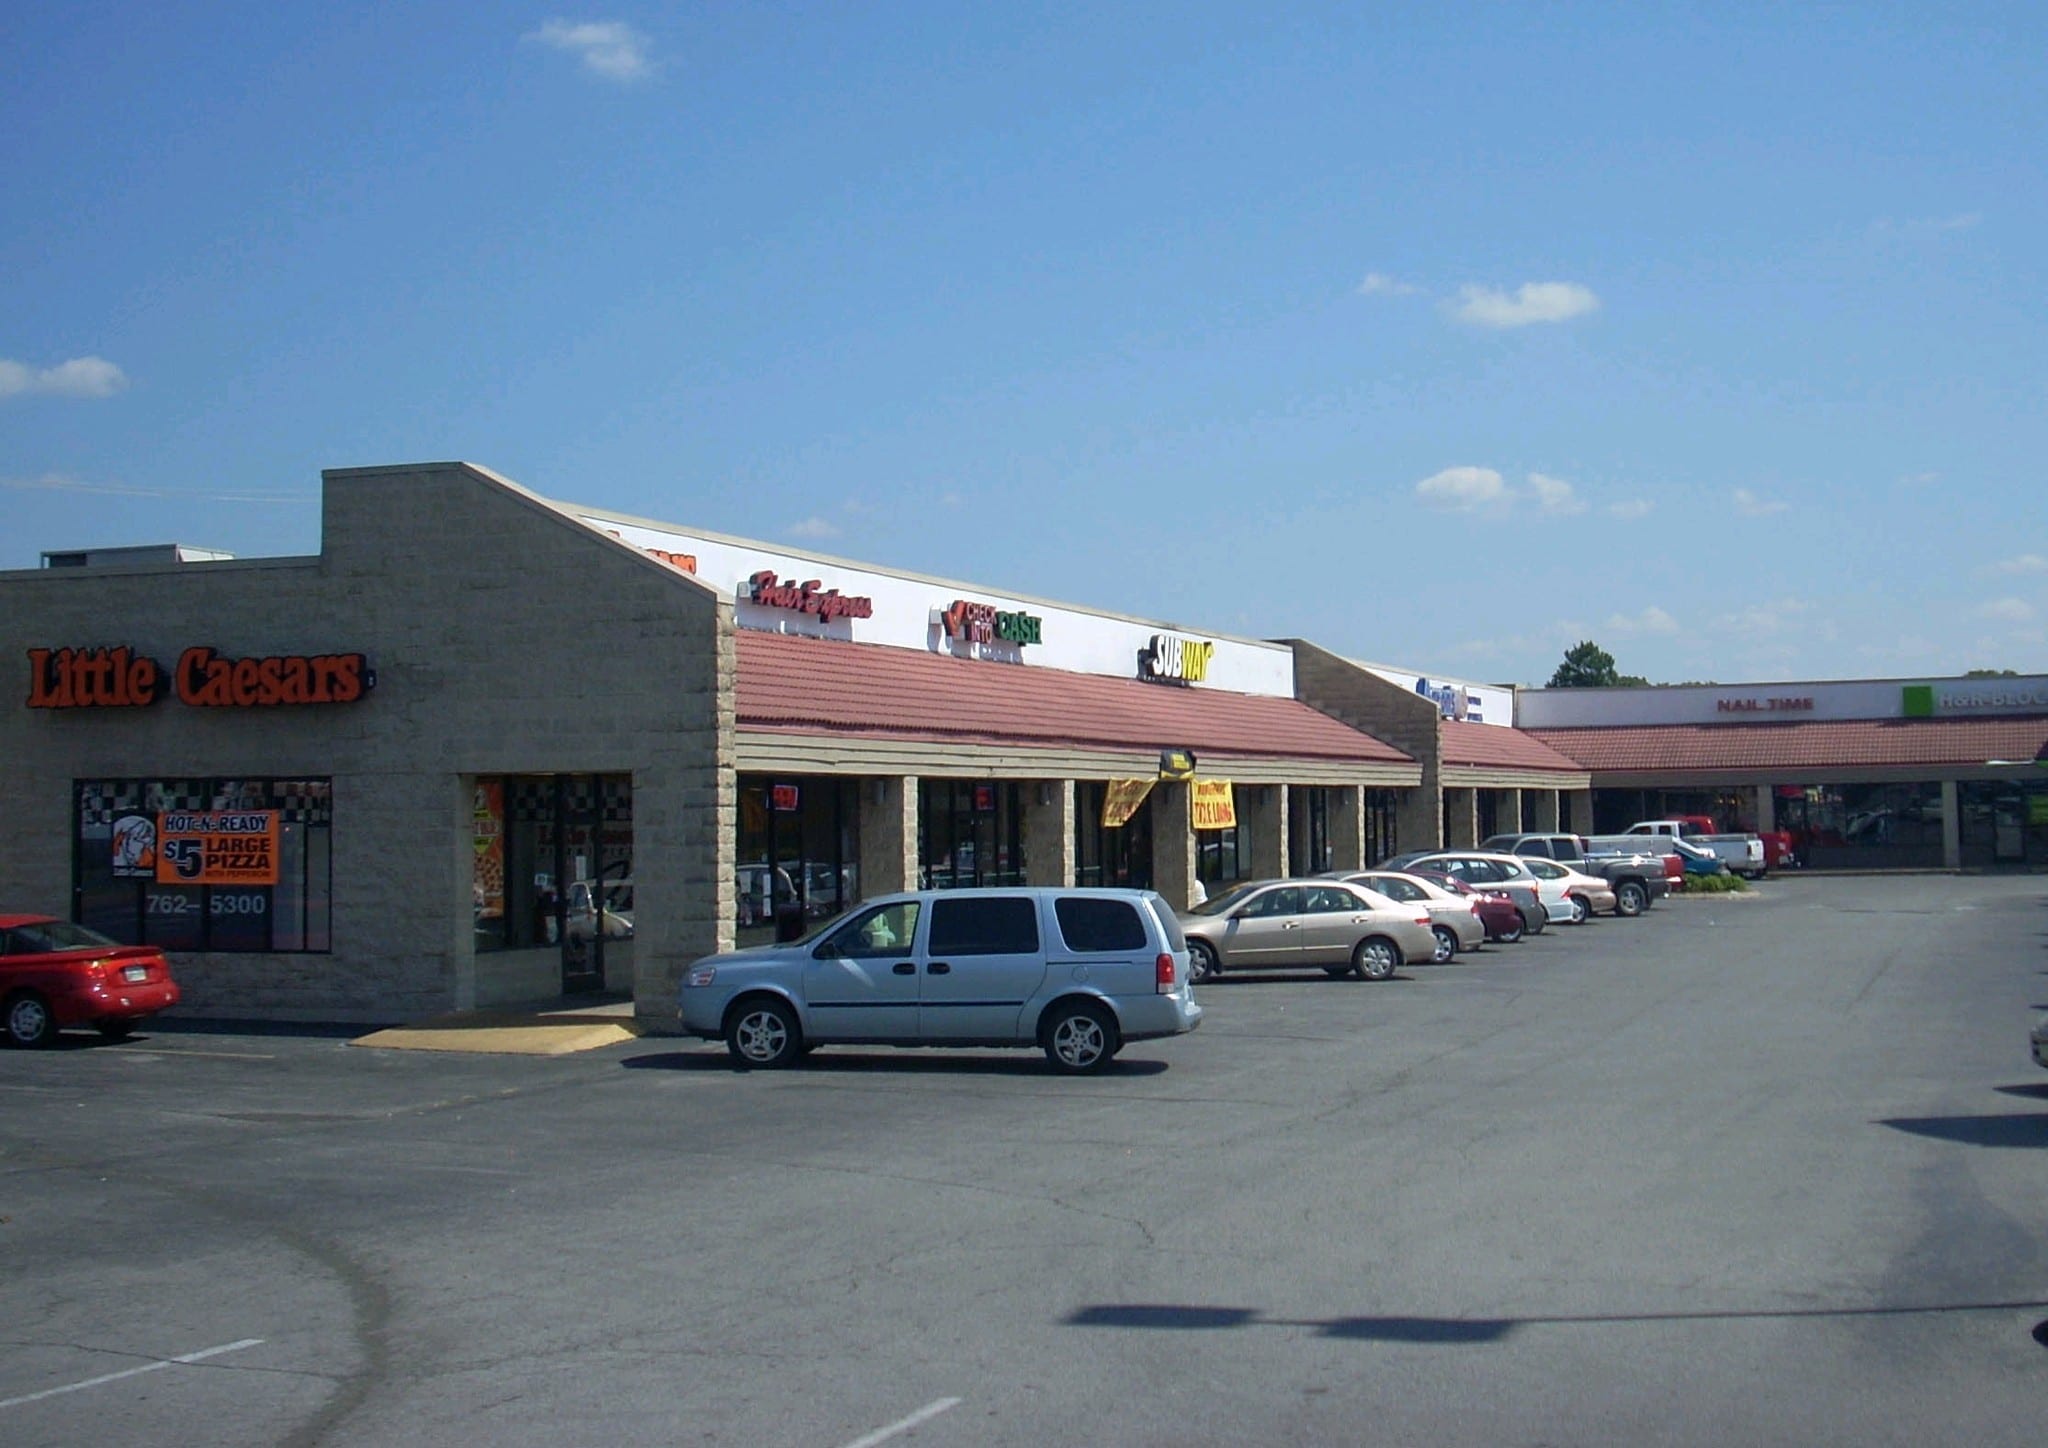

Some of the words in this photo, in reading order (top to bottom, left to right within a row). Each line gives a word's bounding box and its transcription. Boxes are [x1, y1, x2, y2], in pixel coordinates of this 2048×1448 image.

[966, 601, 997, 624] CHECK
[966, 620, 993, 645] INTO
[995, 611, 1042, 645] CASH
[1150, 634, 1215, 682] SUBWAY
[27, 647, 157, 708] Little
[177, 647, 363, 706] Caesars
[1718, 699, 1765, 712] NAIL
[1767, 697, 1814, 711] TIME
[206, 838, 270, 853] LARGE
[164, 839, 203, 878] $5
[206, 854, 270, 869] PIZZA
[210, 895, 266, 914] 5300
